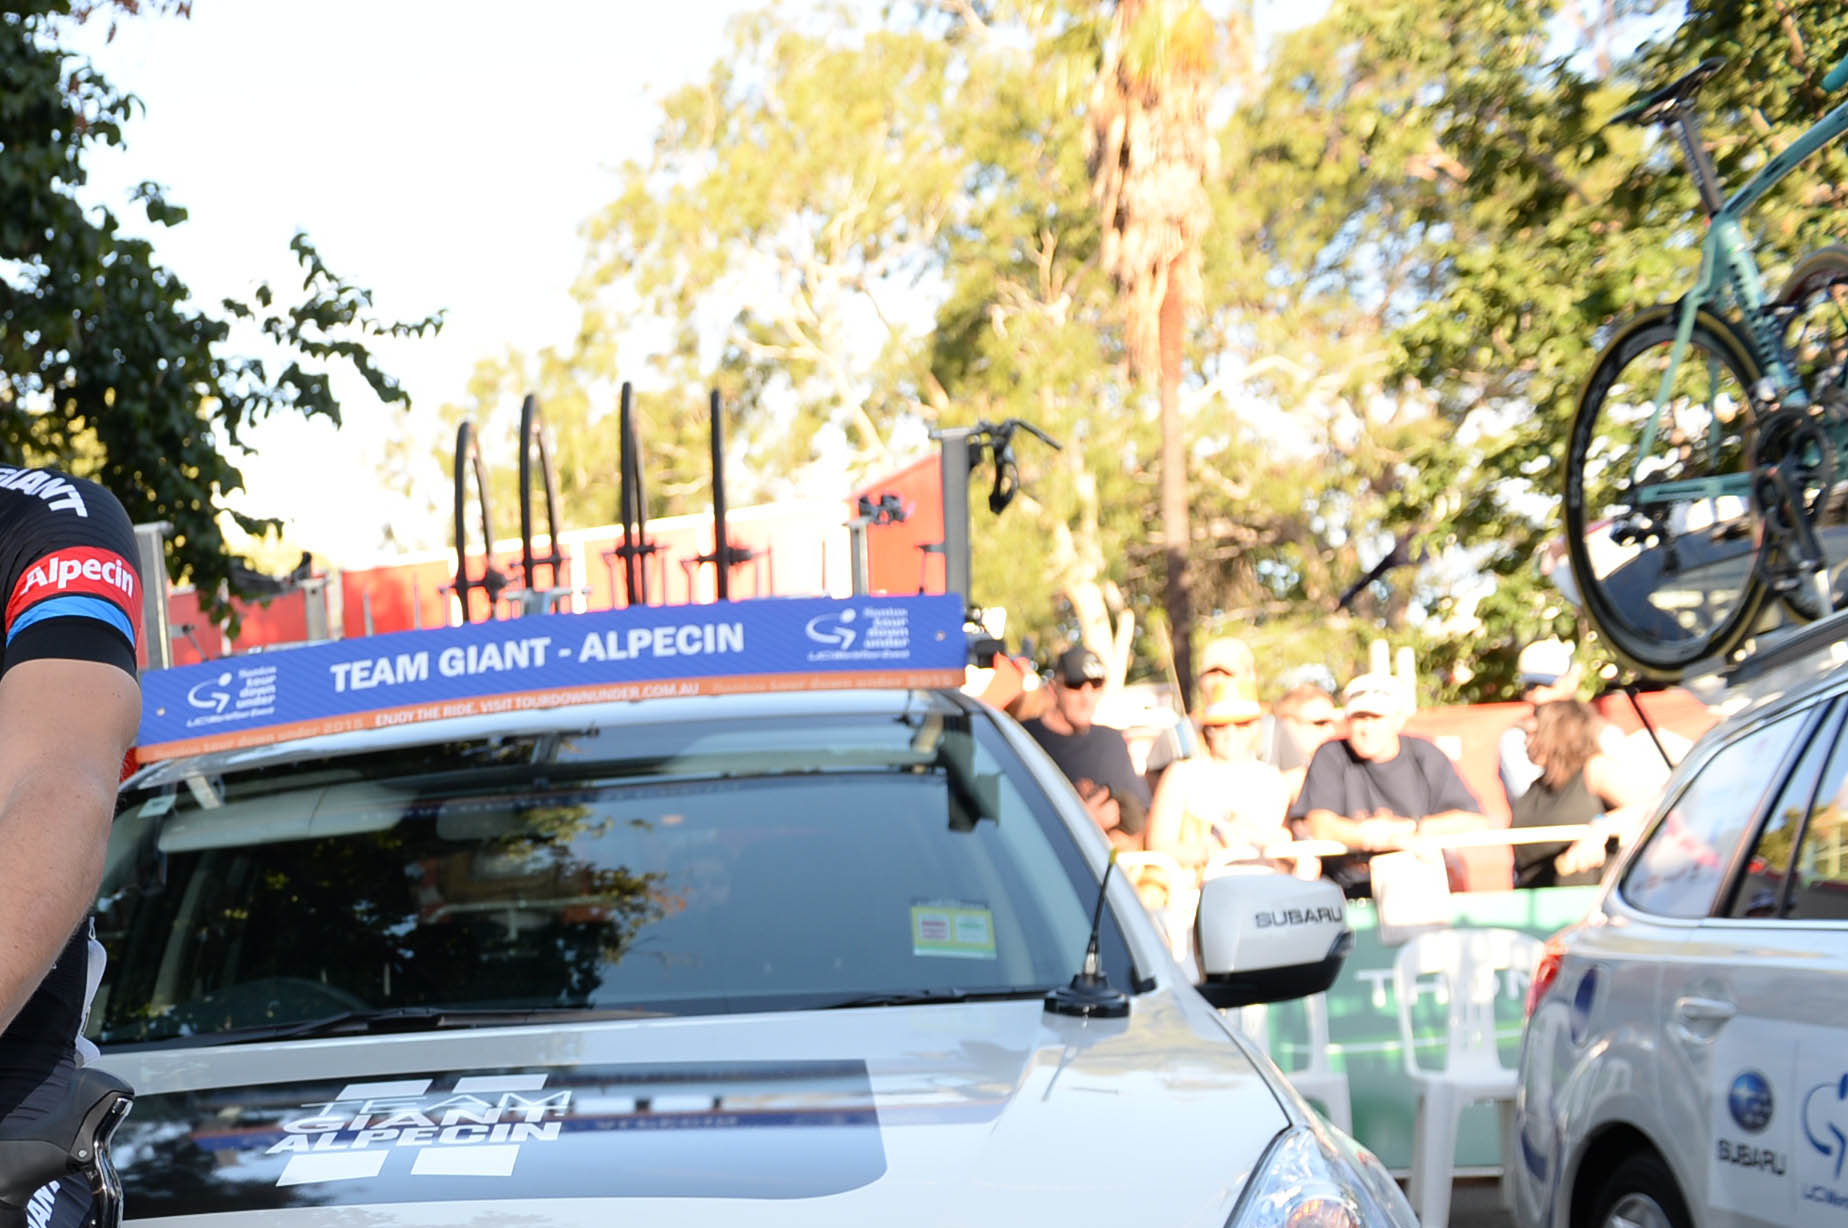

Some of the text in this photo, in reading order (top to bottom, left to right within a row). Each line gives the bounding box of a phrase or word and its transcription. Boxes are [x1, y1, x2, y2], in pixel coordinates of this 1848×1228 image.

[20, 557, 133, 598] Alpecin
[330, 621, 744, 694] TEAM GIANT - ALPECIN
[375, 709, 415, 727] ENJOY
[417, 706, 440, 721] THE
[443, 702, 477, 718] RIDE.
[480, 699, 512, 713] VISIT
[1255, 906, 1343, 928] SUBARU
[283, 1106, 564, 1134] GIANT
[265, 1122, 562, 1154] ALPECIN
[1718, 1139, 1786, 1176] SUBARU
